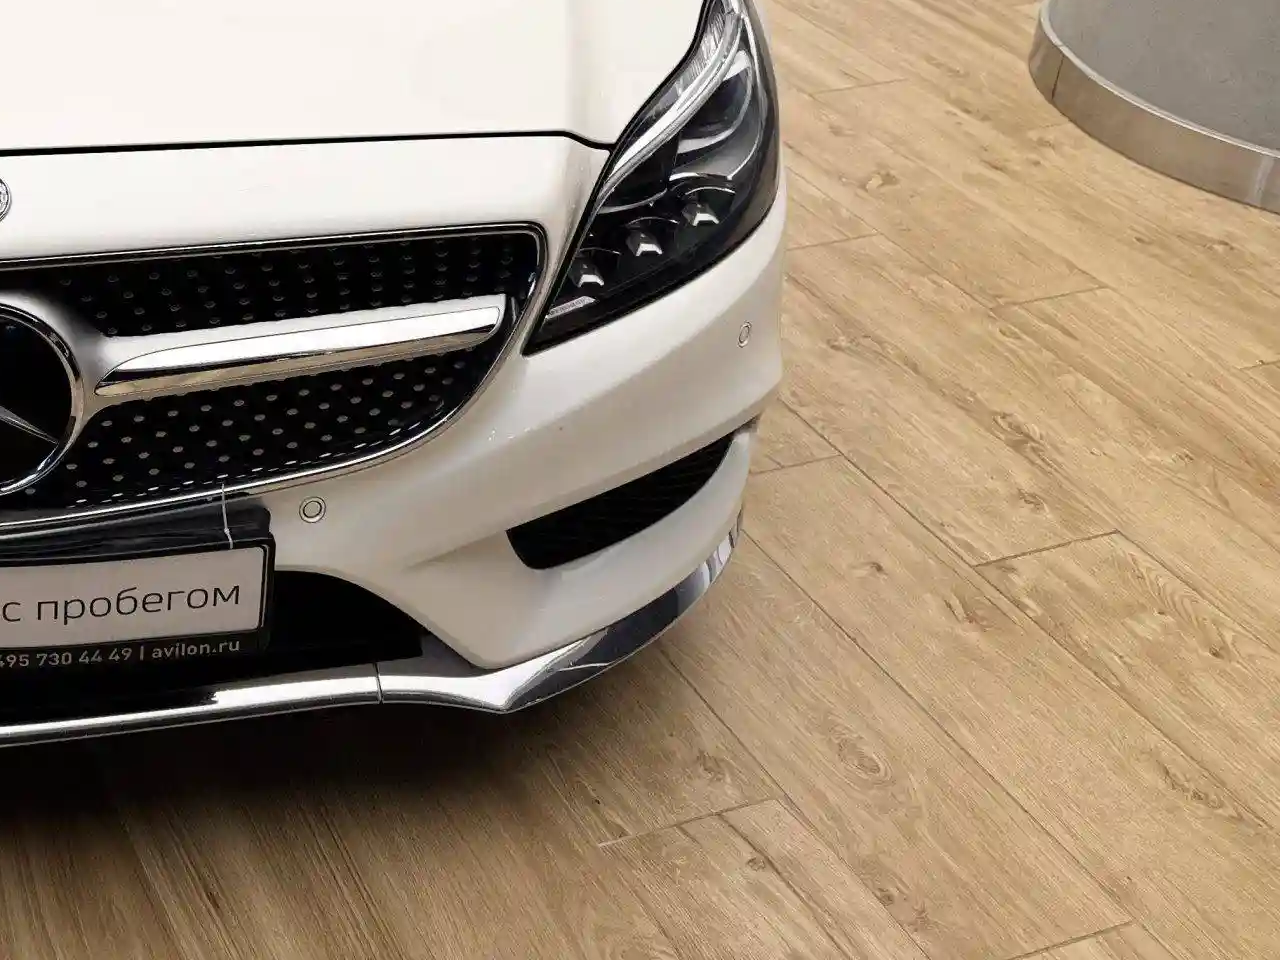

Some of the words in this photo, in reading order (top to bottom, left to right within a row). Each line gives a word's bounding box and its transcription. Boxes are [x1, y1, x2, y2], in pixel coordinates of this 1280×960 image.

[1, 601, 21, 623] с
[36, 585, 240, 626] пробегом
[35, 651, 73, 667] 730
[78, 649, 103, 664] 44
[108, 646, 134, 662] 49
[151, 640, 241, 660] avilon.ru
